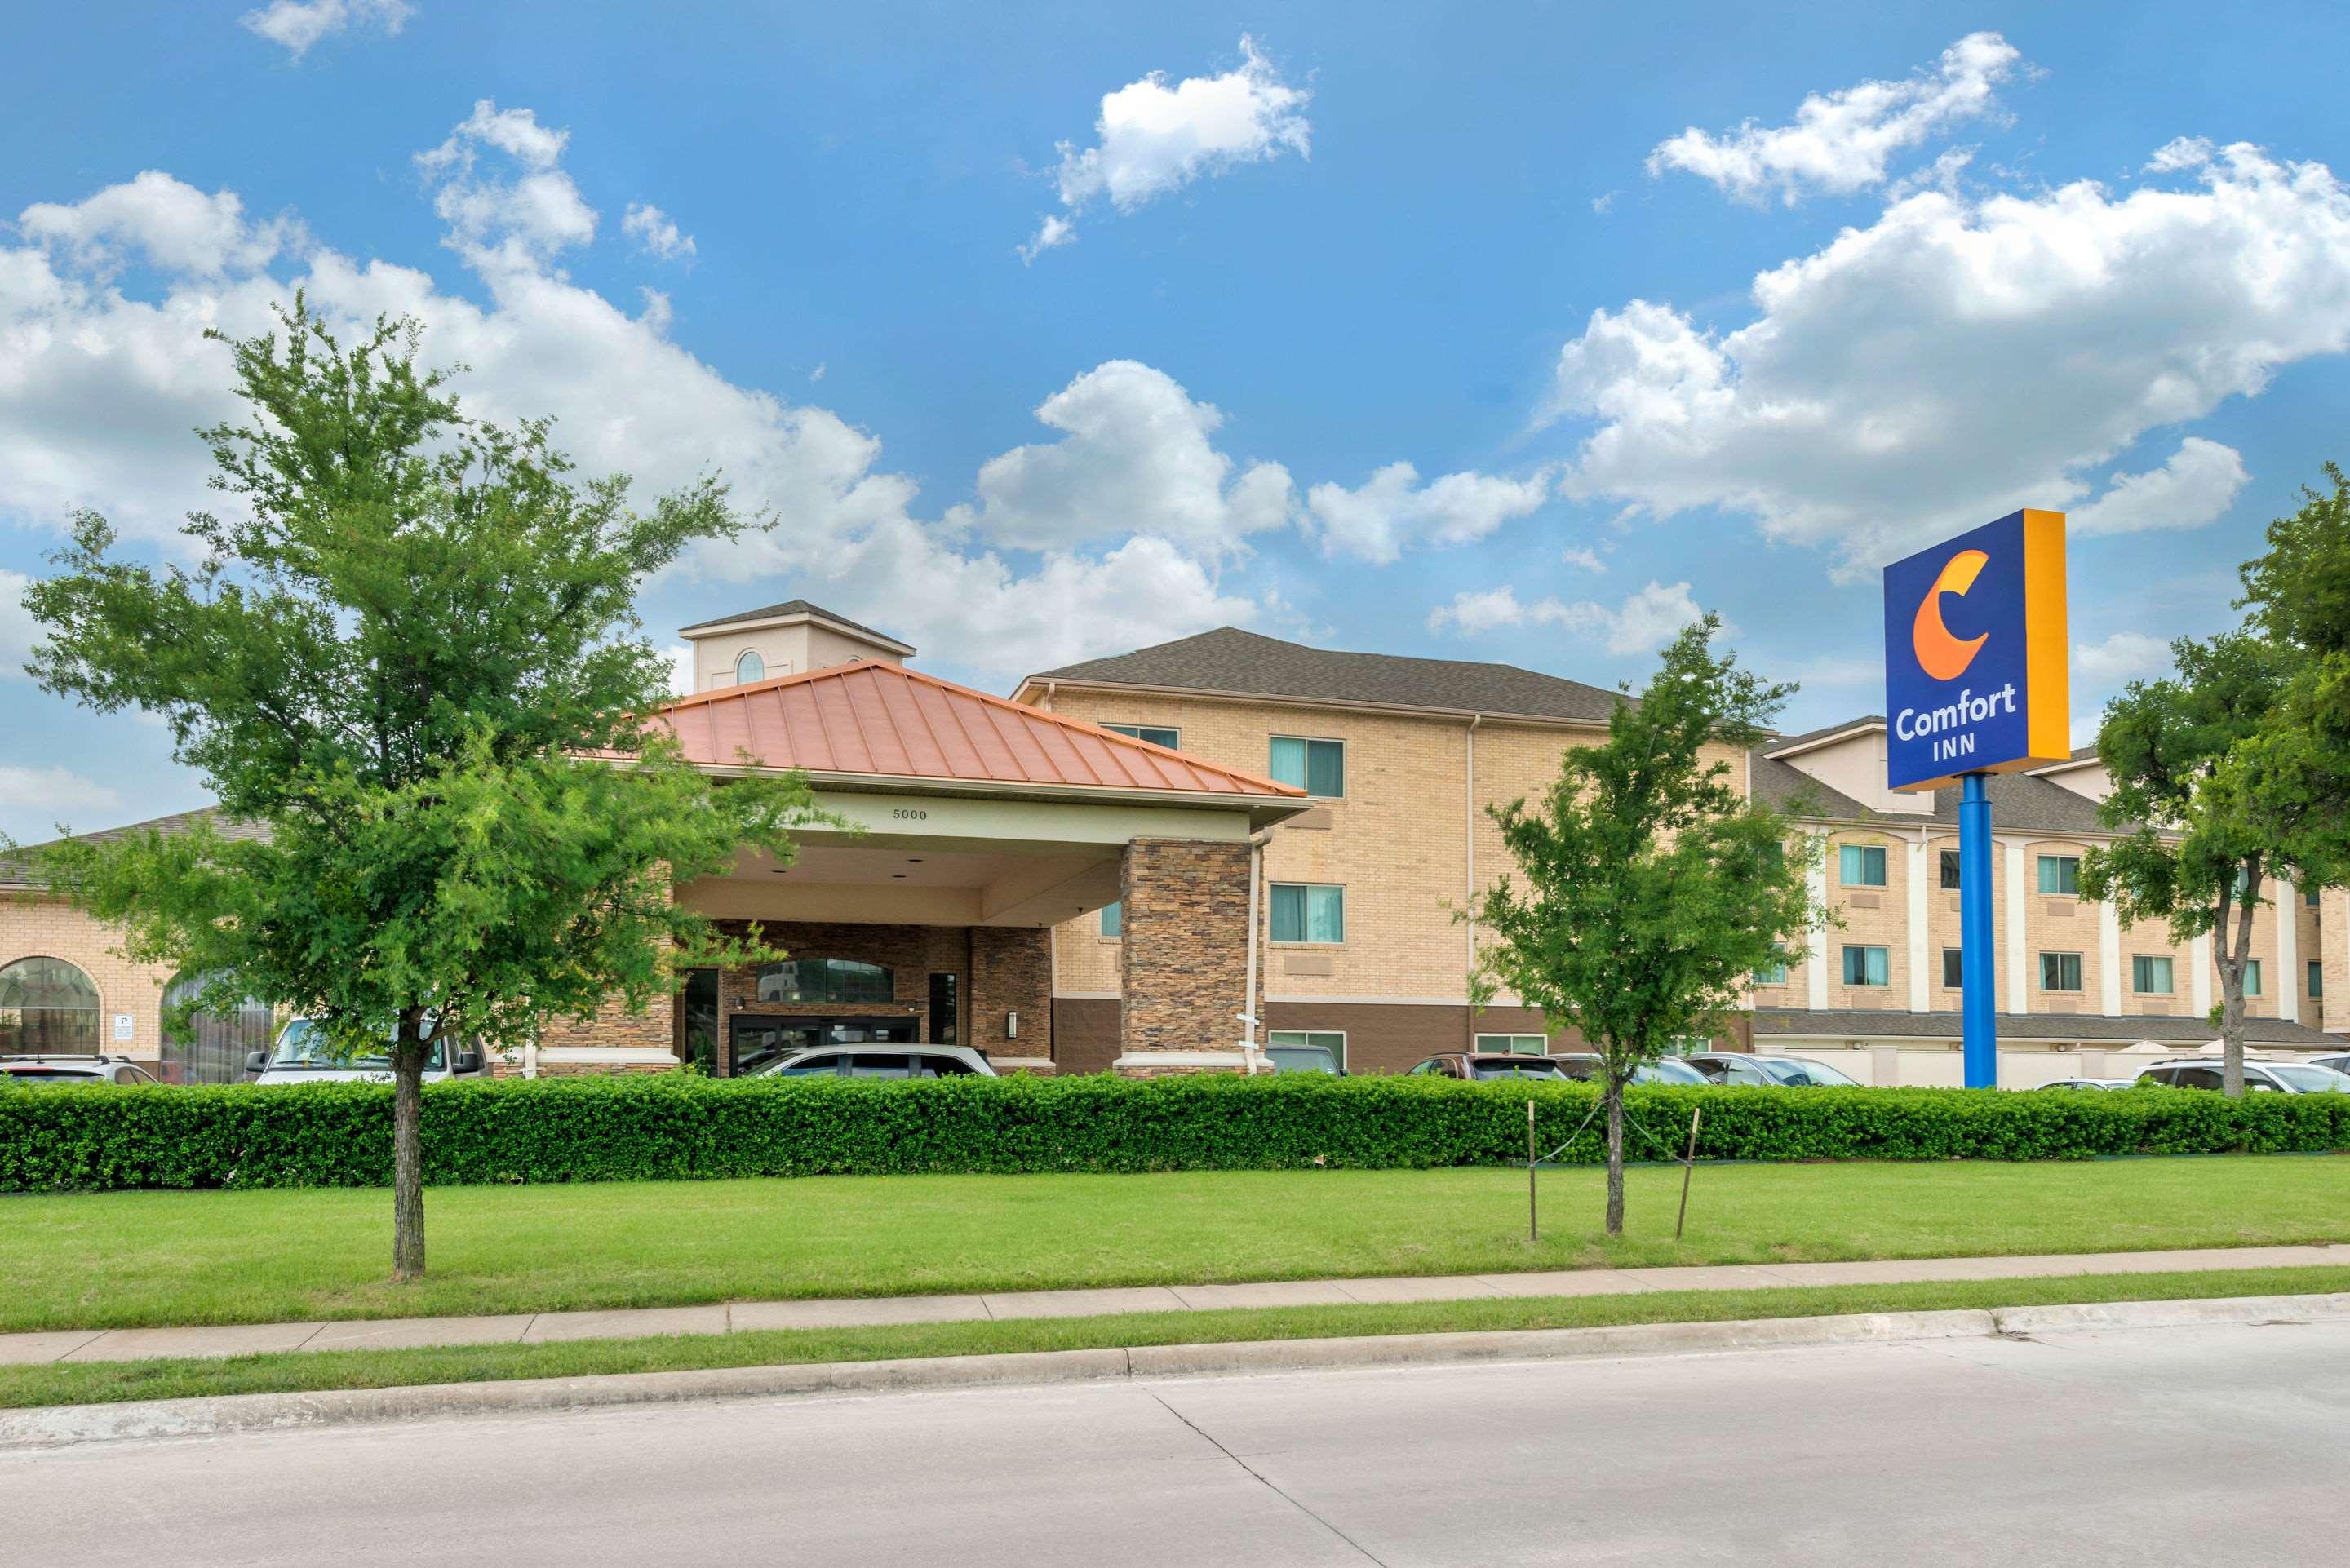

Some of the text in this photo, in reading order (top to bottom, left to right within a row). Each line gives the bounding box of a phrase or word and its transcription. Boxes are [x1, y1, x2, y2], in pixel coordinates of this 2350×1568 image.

[1896, 683, 2016, 741] Comfort
[1933, 732, 1975, 762] INN
[893, 808, 927, 821] 5000
